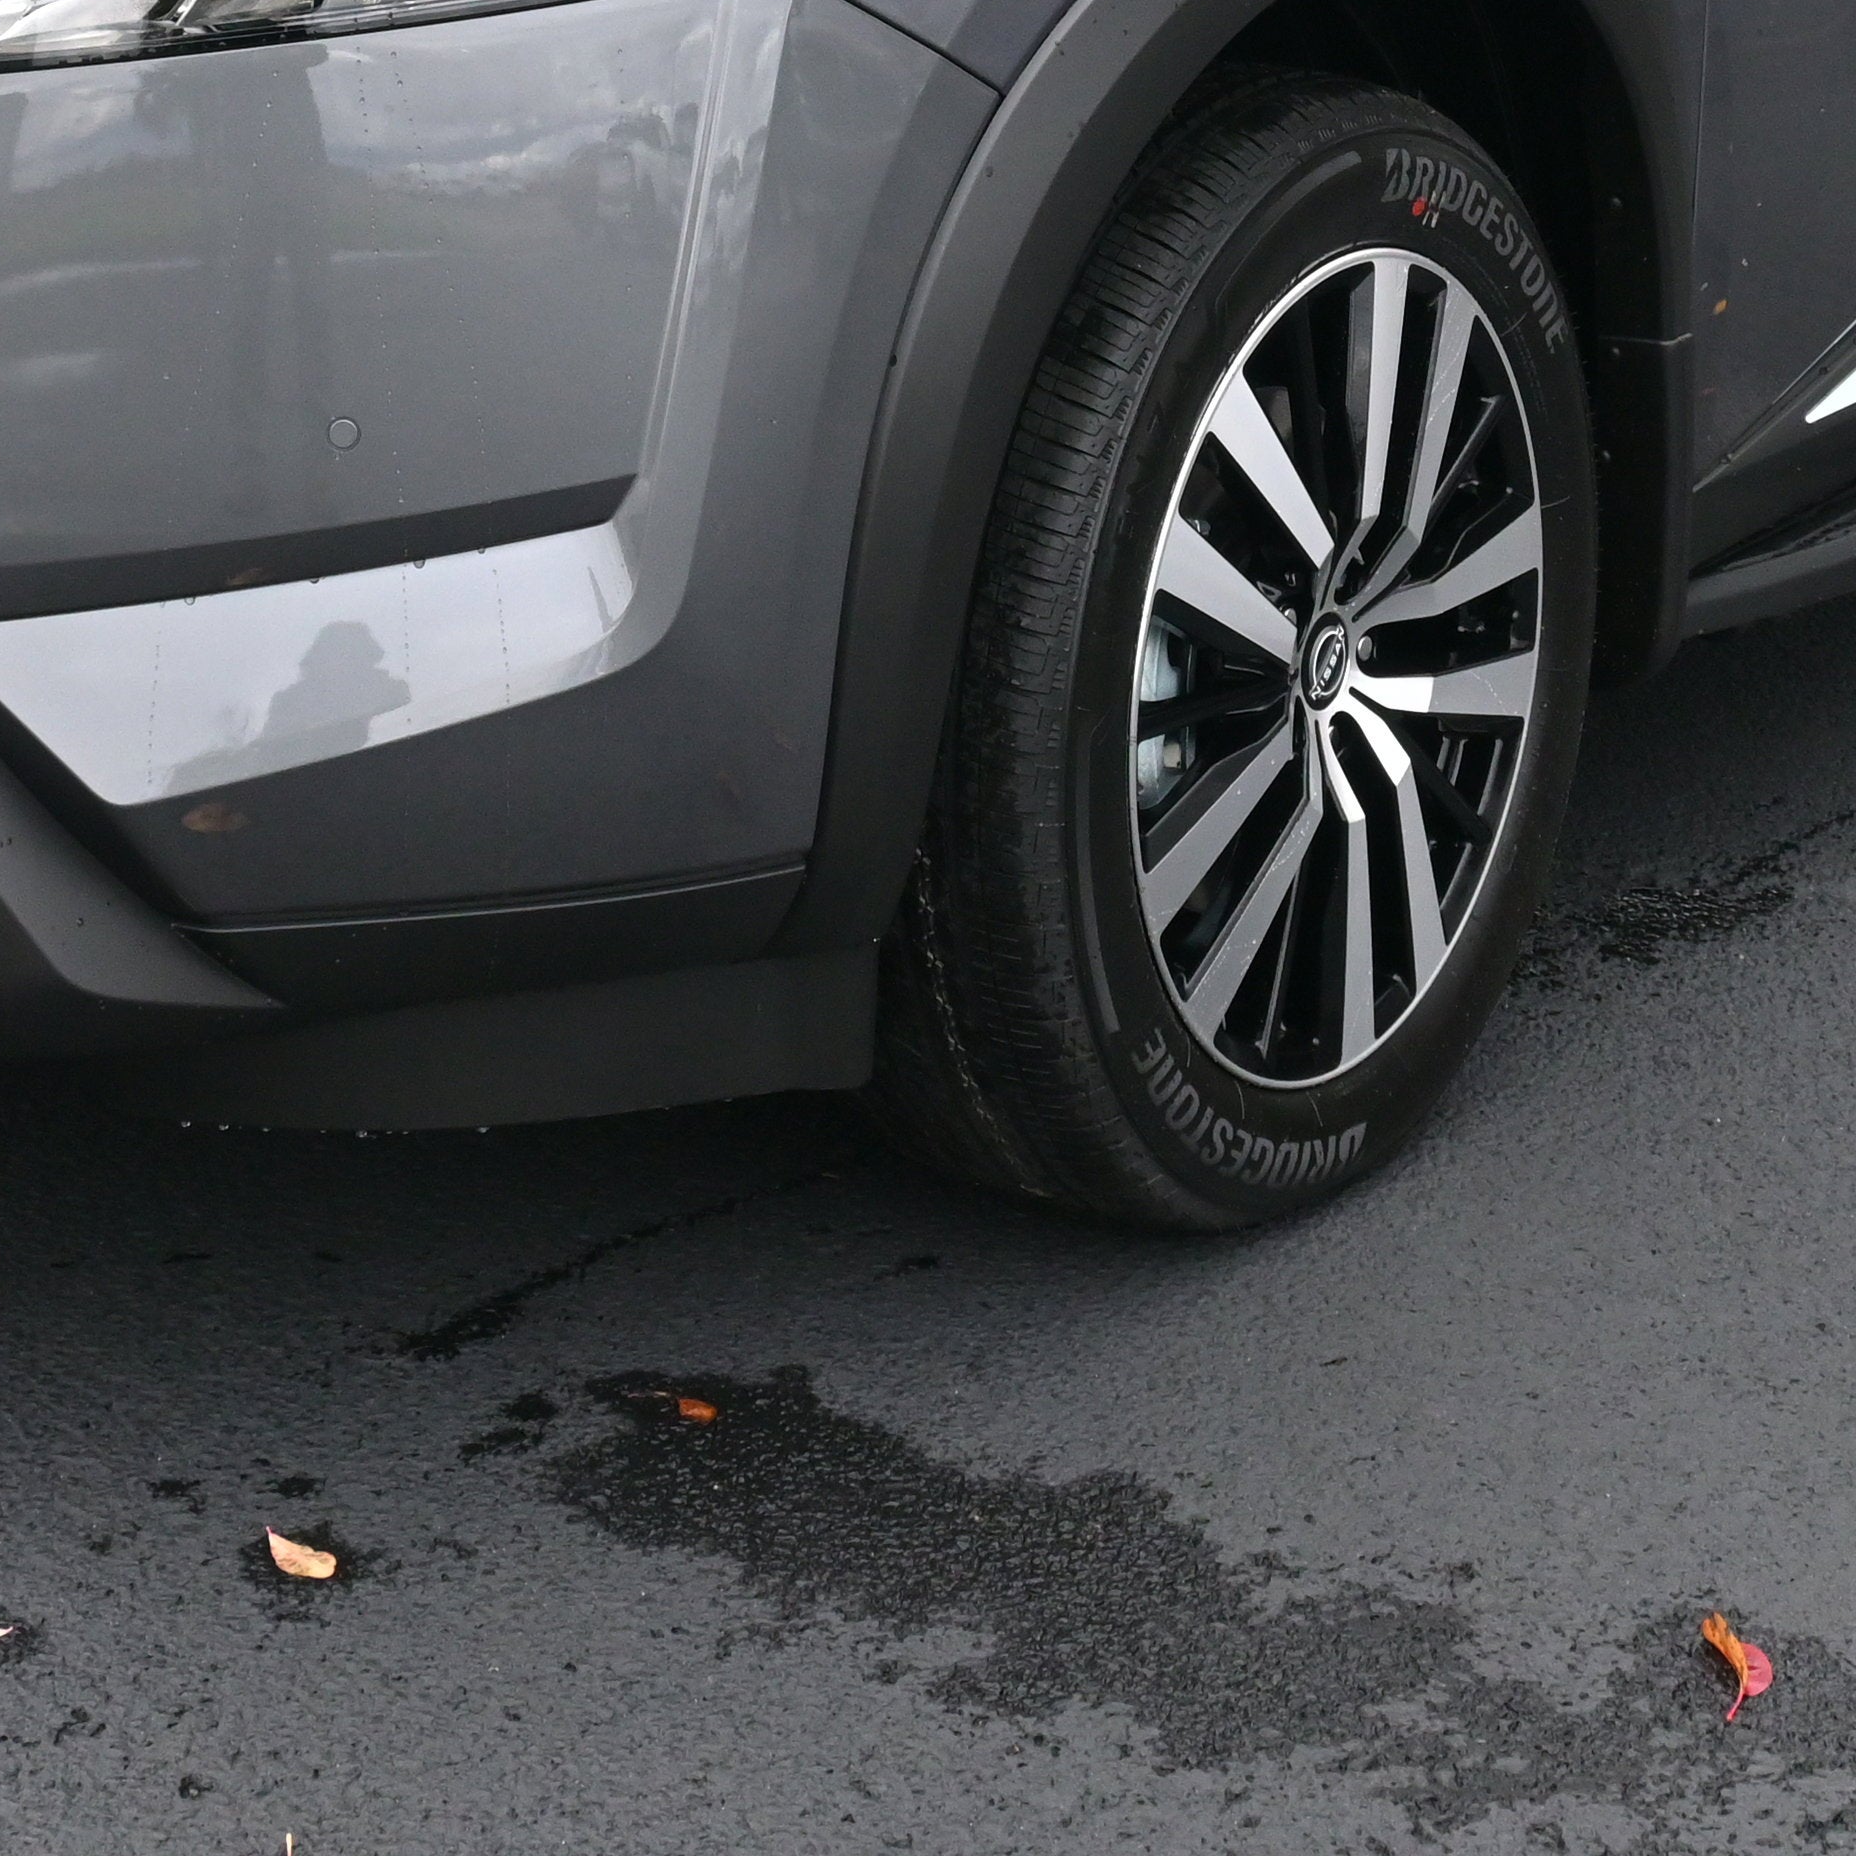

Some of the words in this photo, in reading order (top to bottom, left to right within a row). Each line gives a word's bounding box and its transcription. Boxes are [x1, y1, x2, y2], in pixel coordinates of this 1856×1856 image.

[1380, 147, 1570, 355] BRIDGESTONE
[1310, 624, 1345, 701] NISSAN
[1131, 1027, 1368, 1187] BRIDGESTONE
